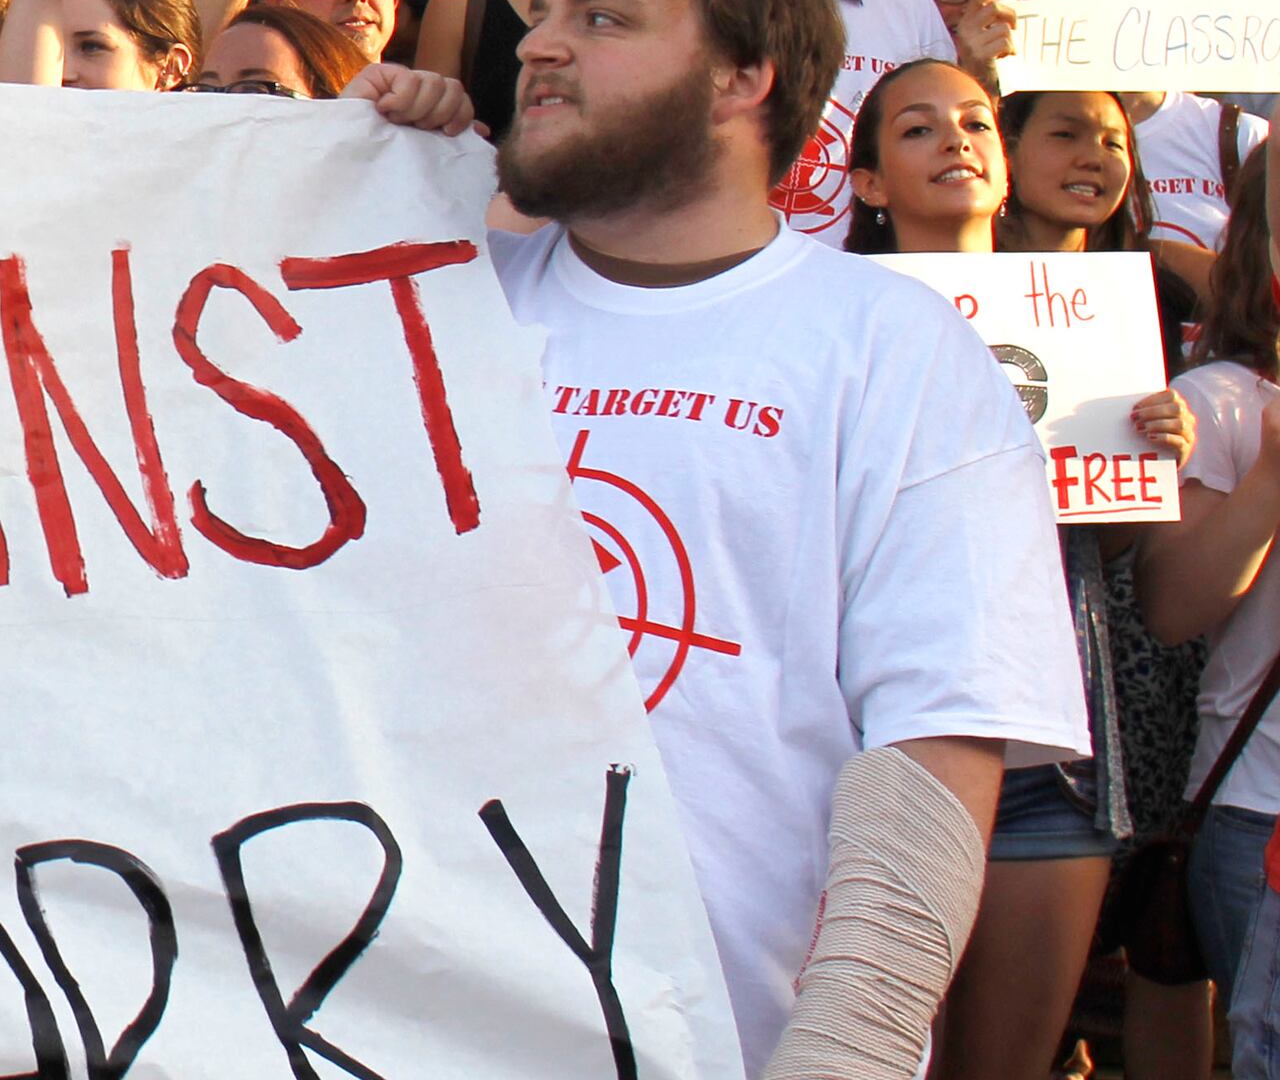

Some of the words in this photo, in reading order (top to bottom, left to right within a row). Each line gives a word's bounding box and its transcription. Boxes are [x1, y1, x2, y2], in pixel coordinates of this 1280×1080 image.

[1017, 14, 1091, 67] THE
[1024, 260, 1095, 328] the
[551, 386, 715, 421] TARGET
[724, 399, 784, 437] US
[1050, 446, 1162, 509] FREE
